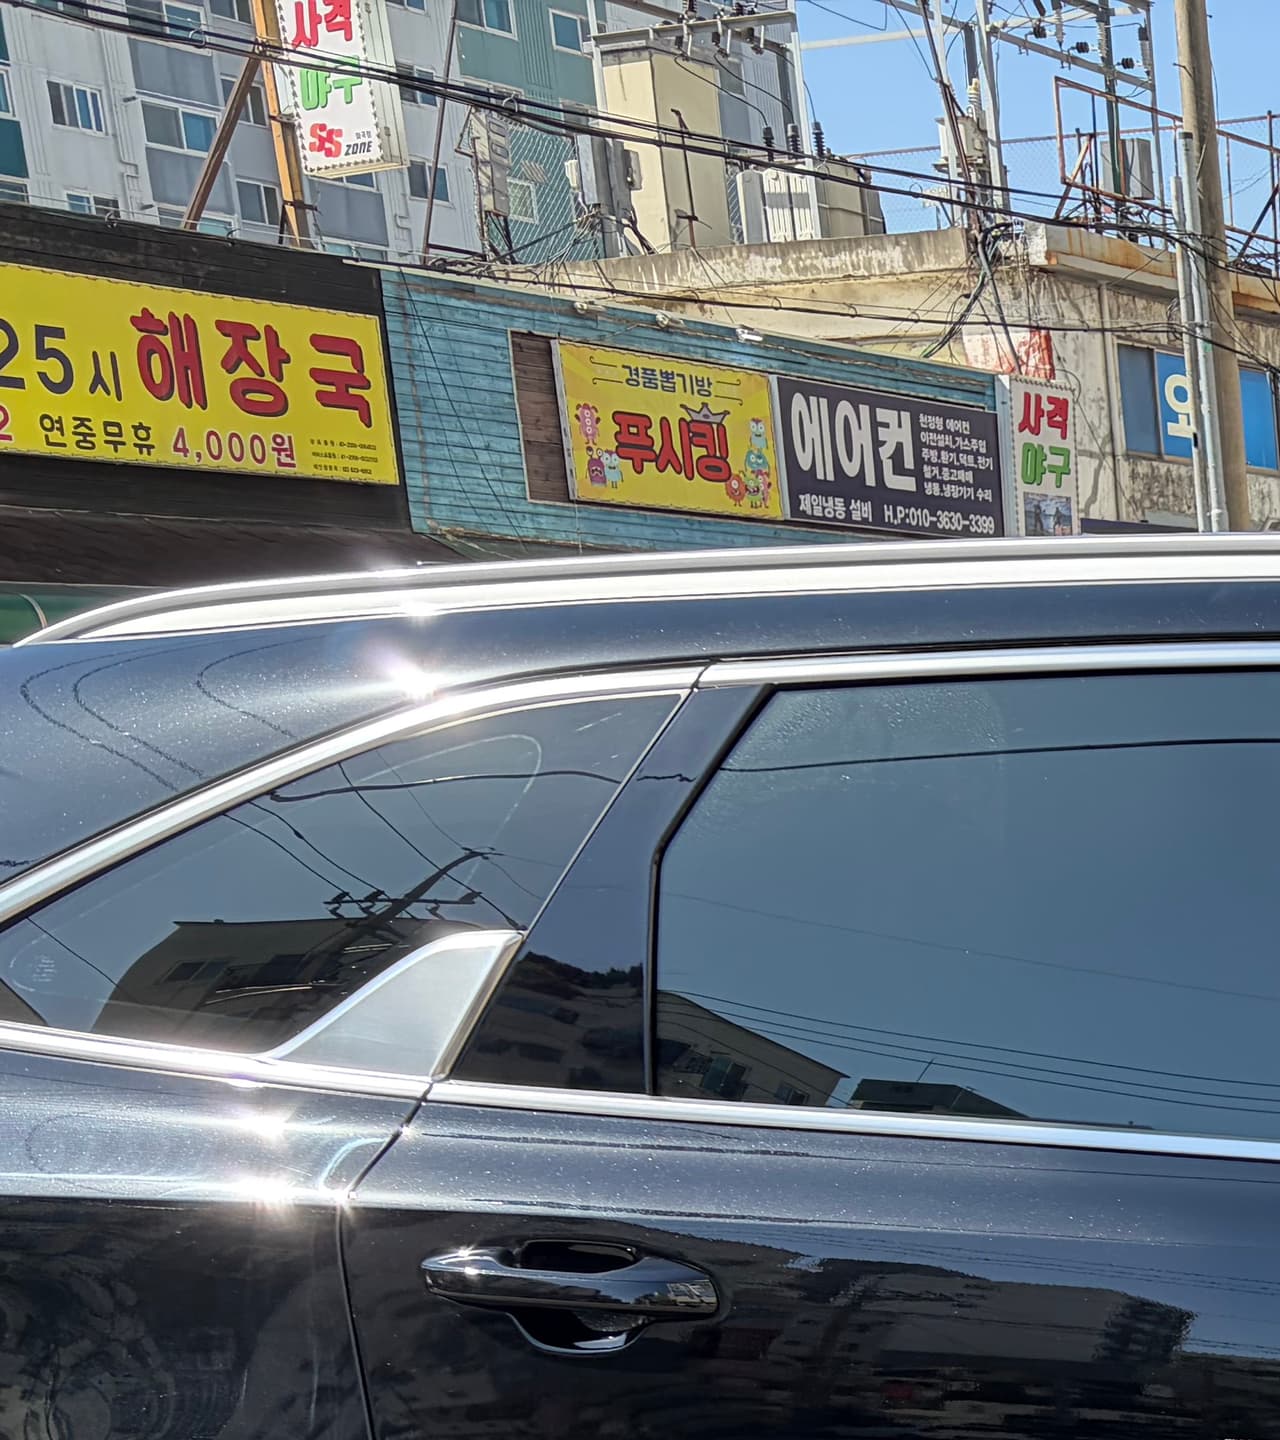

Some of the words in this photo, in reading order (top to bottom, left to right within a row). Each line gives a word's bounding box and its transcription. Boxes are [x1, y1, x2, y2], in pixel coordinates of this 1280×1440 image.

[292, 0, 353, 48] 사격
[300, 55, 363, 111] 야구
[344, 141, 373, 156] ZONE
[130, 307, 372, 429] 해장국
[622, 364, 713, 398] 경품뽑기방
[945, 418, 970, 434] 에어컨
[1018, 391, 1069, 440] 사격
[39, 413, 155, 456] 연중무휴
[173, 427, 296, 468] 4,000원
[612, 411, 732, 483] 푸시킹
[791, 392, 917, 492] 에어컨
[1021, 442, 1071, 488] 야구
[799, 493, 847, 520] 제일냉동
[849, 499, 873, 523] 설비
[976, 487, 993, 502] 수리
